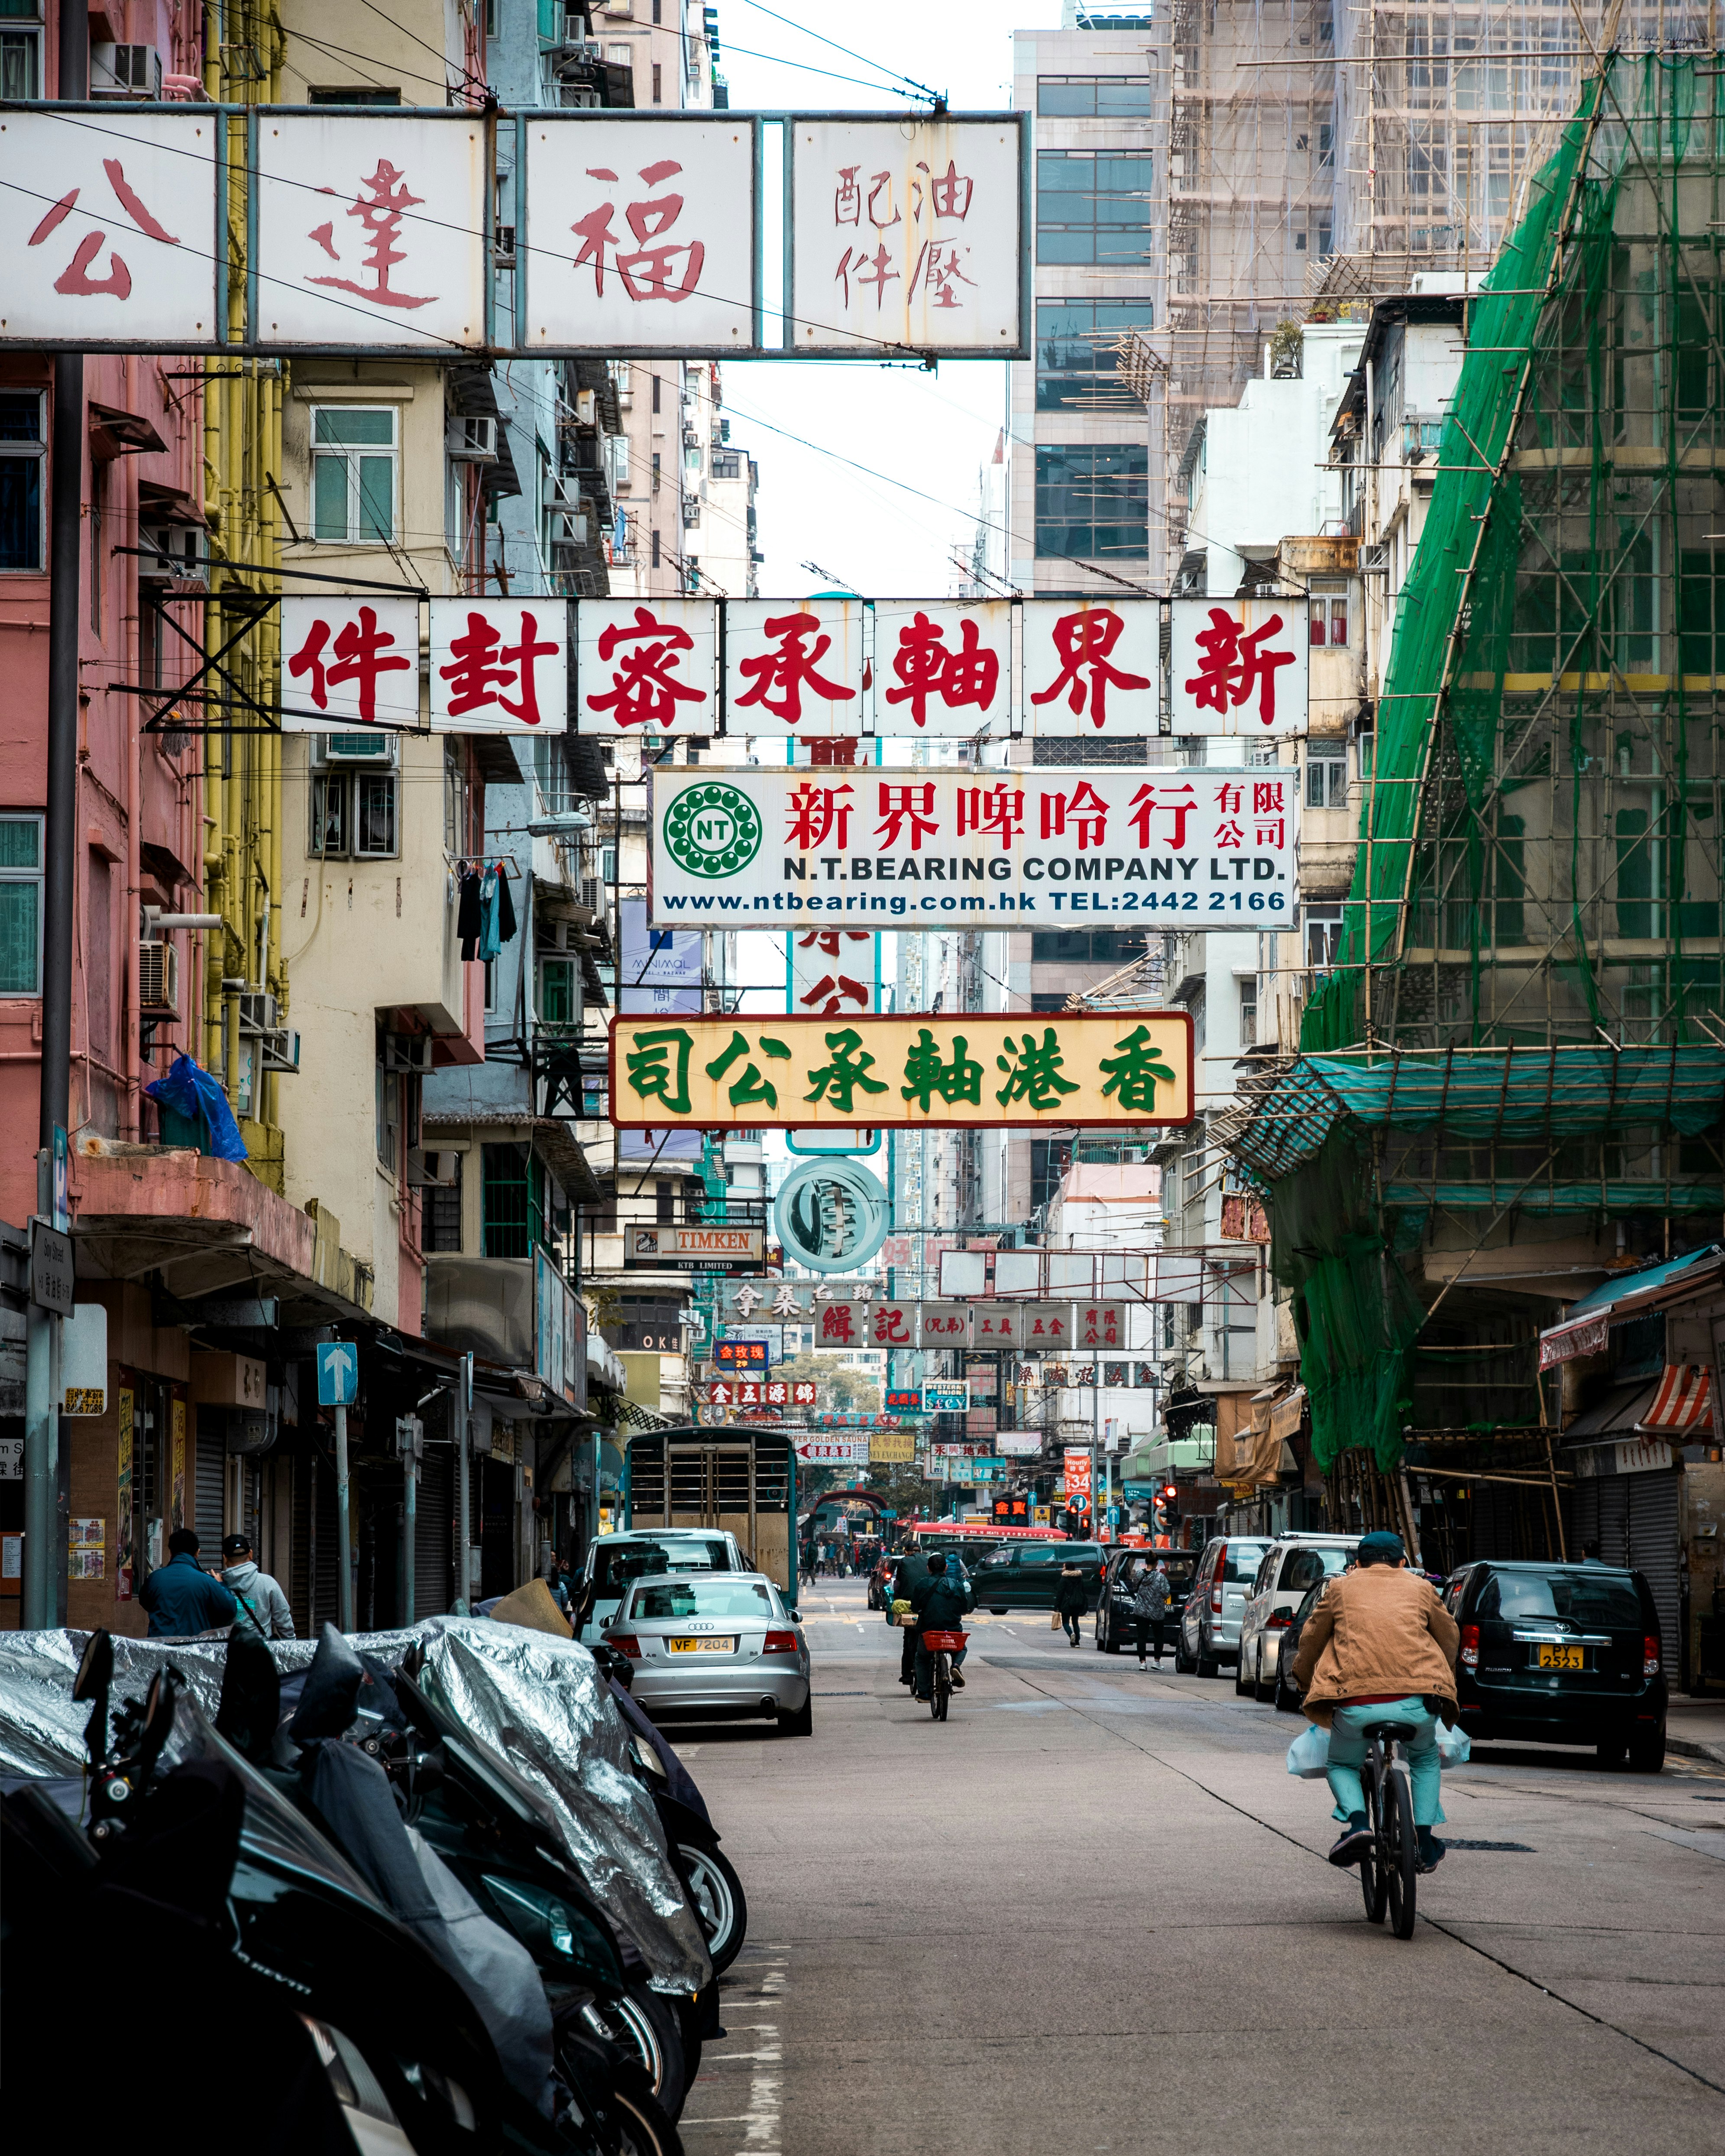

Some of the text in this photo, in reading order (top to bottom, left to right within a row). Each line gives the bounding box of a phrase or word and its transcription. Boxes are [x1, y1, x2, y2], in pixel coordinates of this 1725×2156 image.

[697, 820, 729, 840] NT
[784, 857, 1285, 881] N.T.BEARING COMPANY LTD.
[663, 892, 1285, 915] www.ntbearing.com.hk TEL:2442 2166
[679, 1232, 750, 1249] TIMKEN
[52, 1241, 64, 1264] Street
[720, 1345, 764, 1359] 金玫瑰
[66, 1403, 83, 1412] 946
[882, 1451, 913, 1460] EXCHANGE
[1066, 1474, 1090, 1488] $34
[675, 1640, 729, 1650] VF 7204
[1553, 1646, 1570, 1656] PY
[1543, 1656, 1579, 1668] 2523
